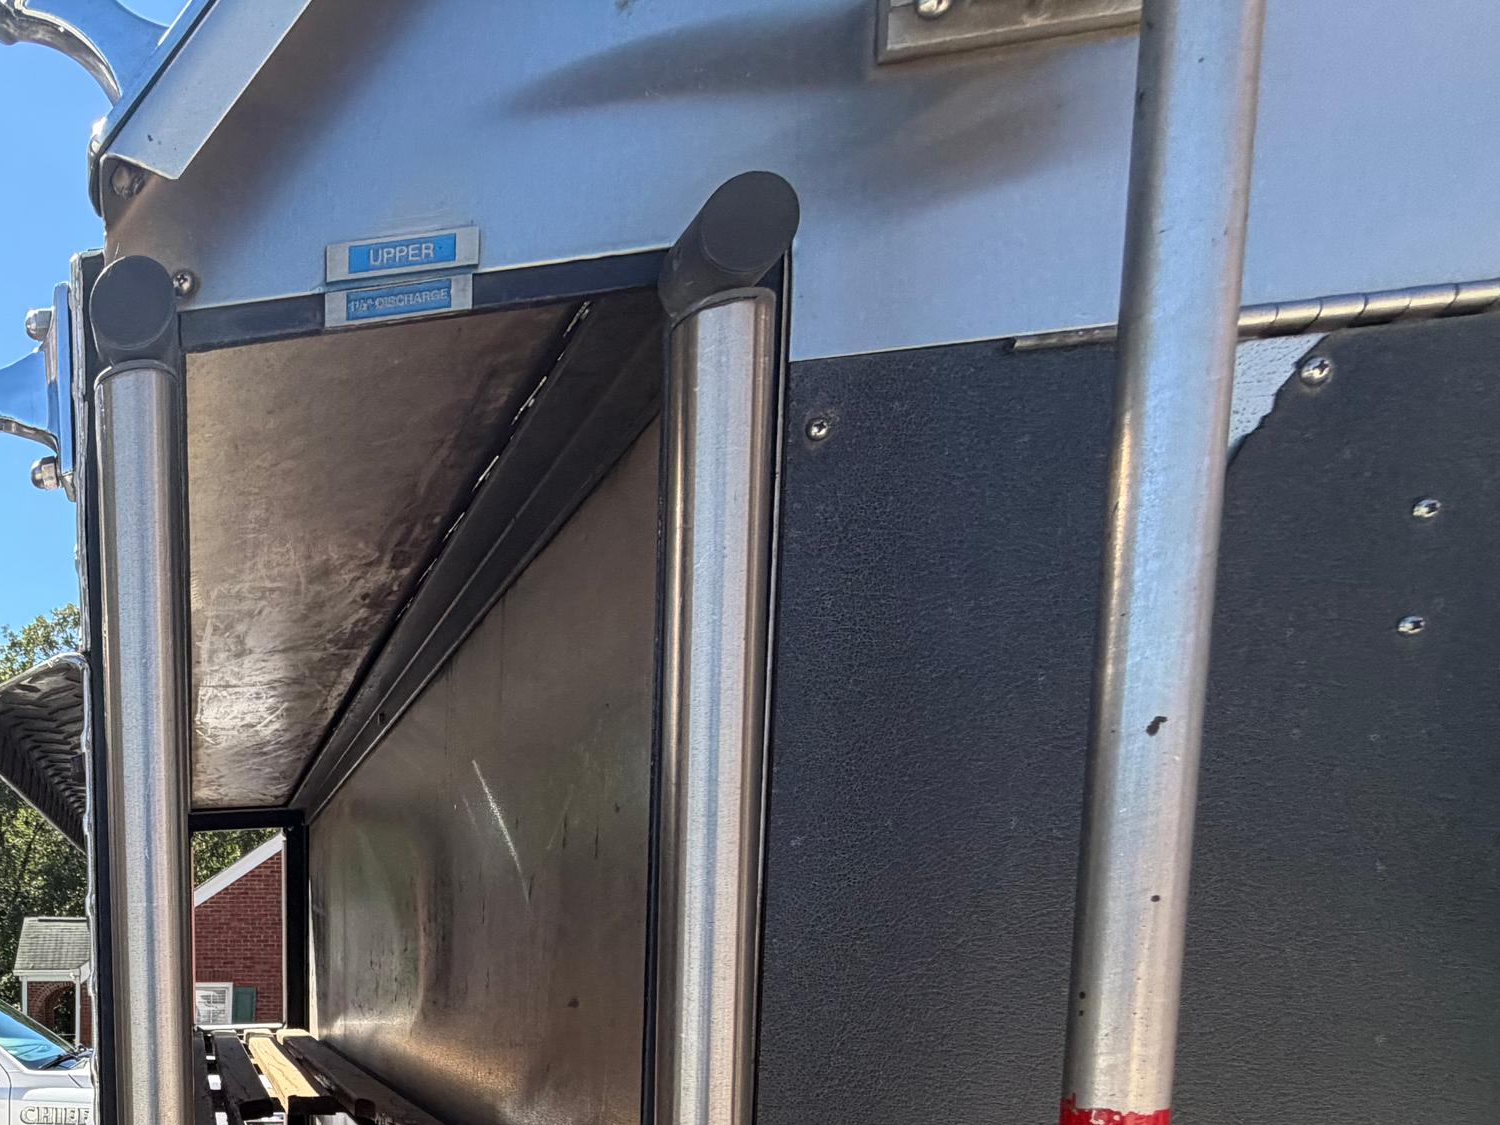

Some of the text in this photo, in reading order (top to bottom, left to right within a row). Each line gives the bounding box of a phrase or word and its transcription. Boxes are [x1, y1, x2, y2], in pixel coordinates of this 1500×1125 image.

[369, 242, 435, 266] UPPER
[375, 288, 449, 310] DISCHARGE
[20, 1106, 90, 1125] CHIEF
